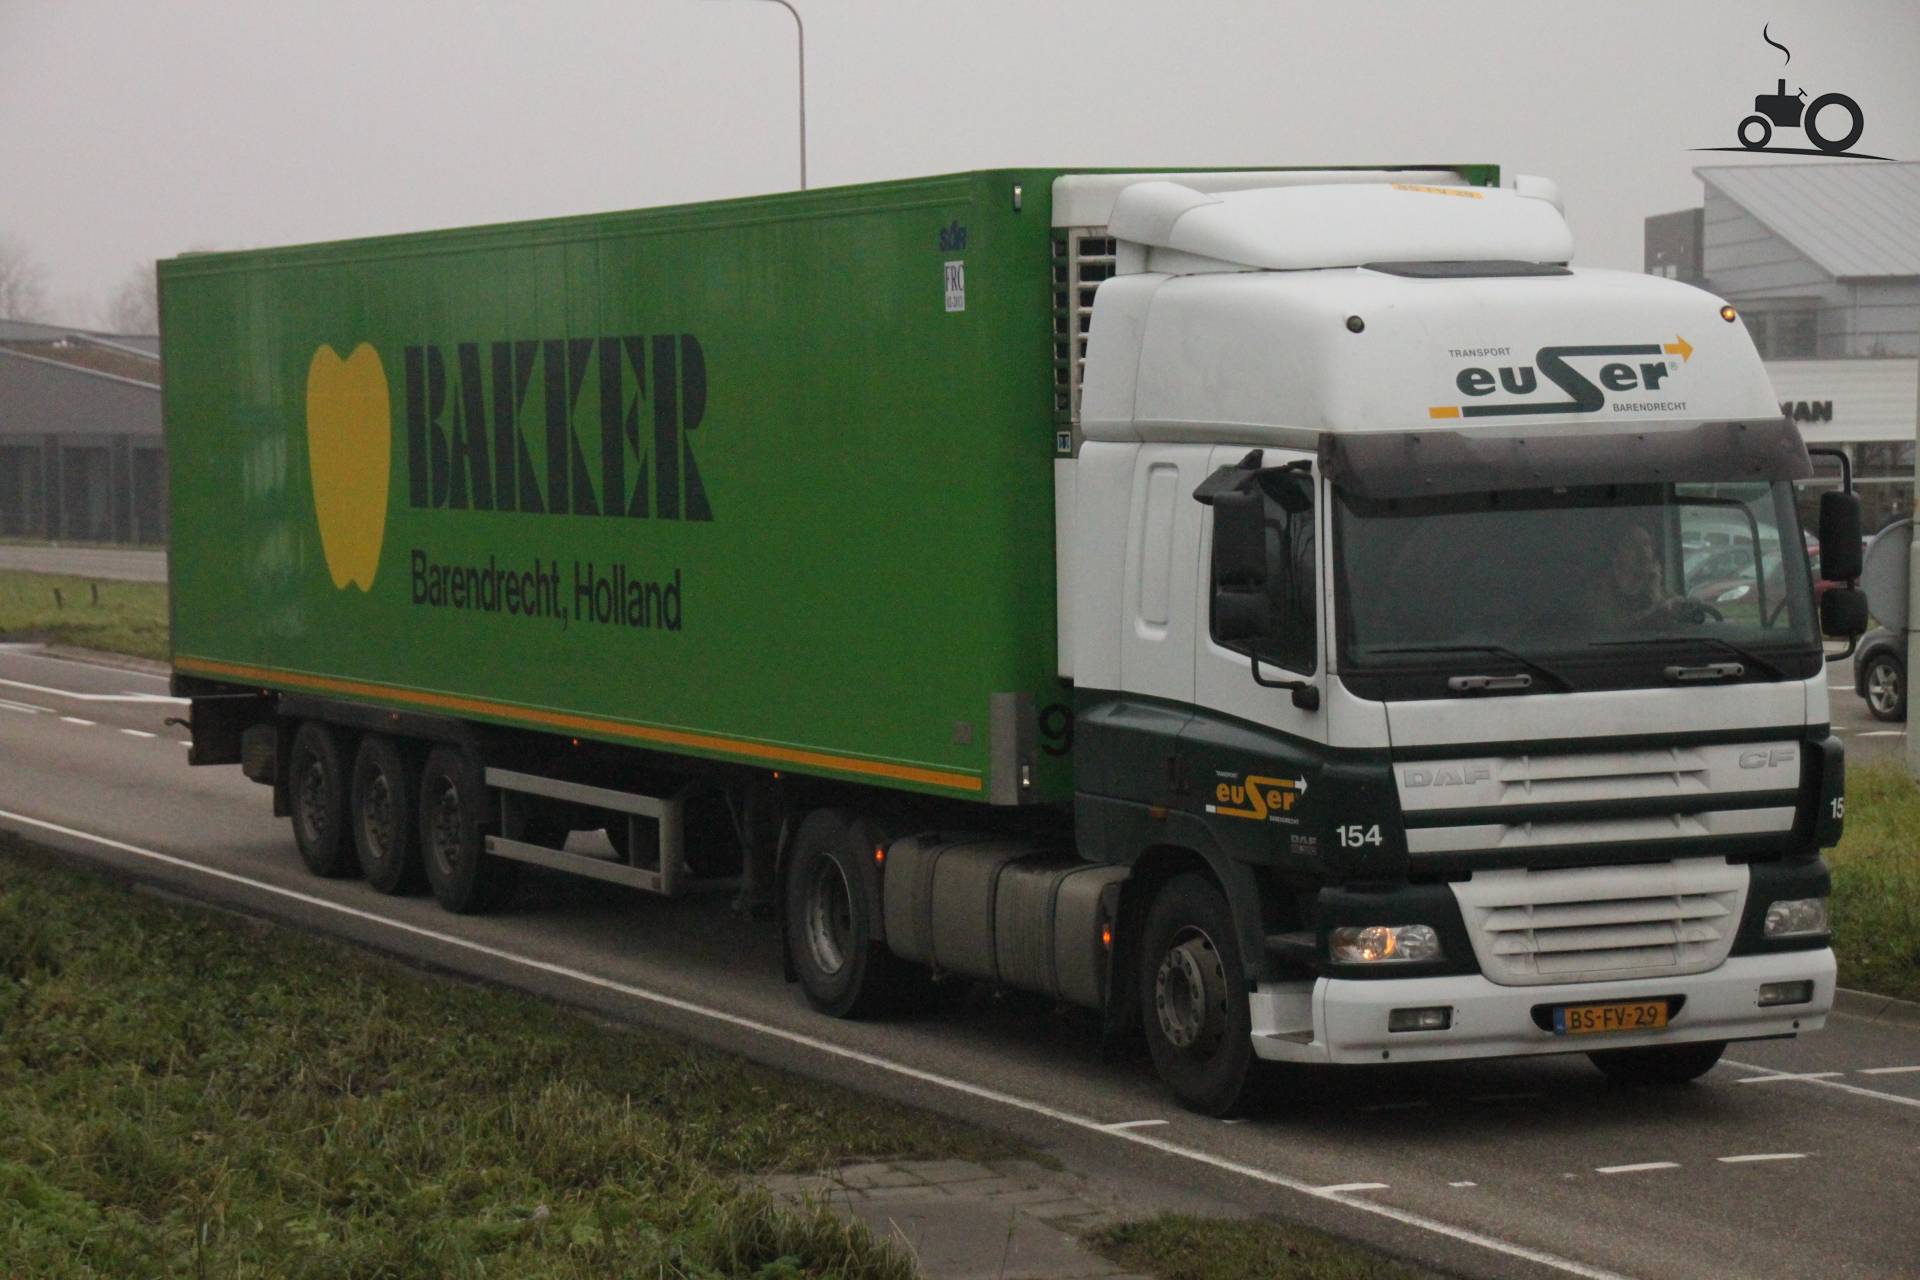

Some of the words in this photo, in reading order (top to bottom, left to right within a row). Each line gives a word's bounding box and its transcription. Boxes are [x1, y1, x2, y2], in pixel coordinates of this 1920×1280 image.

[945, 265, 965, 292] FRC
[1449, 348, 1511, 358] TRANSPORT
[1612, 402, 1687, 412] BARENDRECHT
[404, 333, 714, 522] BAKKER
[411, 549, 568, 630] Barendrecht,
[575, 561, 682, 631] Holland
[1739, 750, 1796, 769] CF
[1403, 766, 1491, 788] DAF
[1336, 824, 1383, 848] 154
[1570, 1005, 1658, 1030] BS-FV-29
